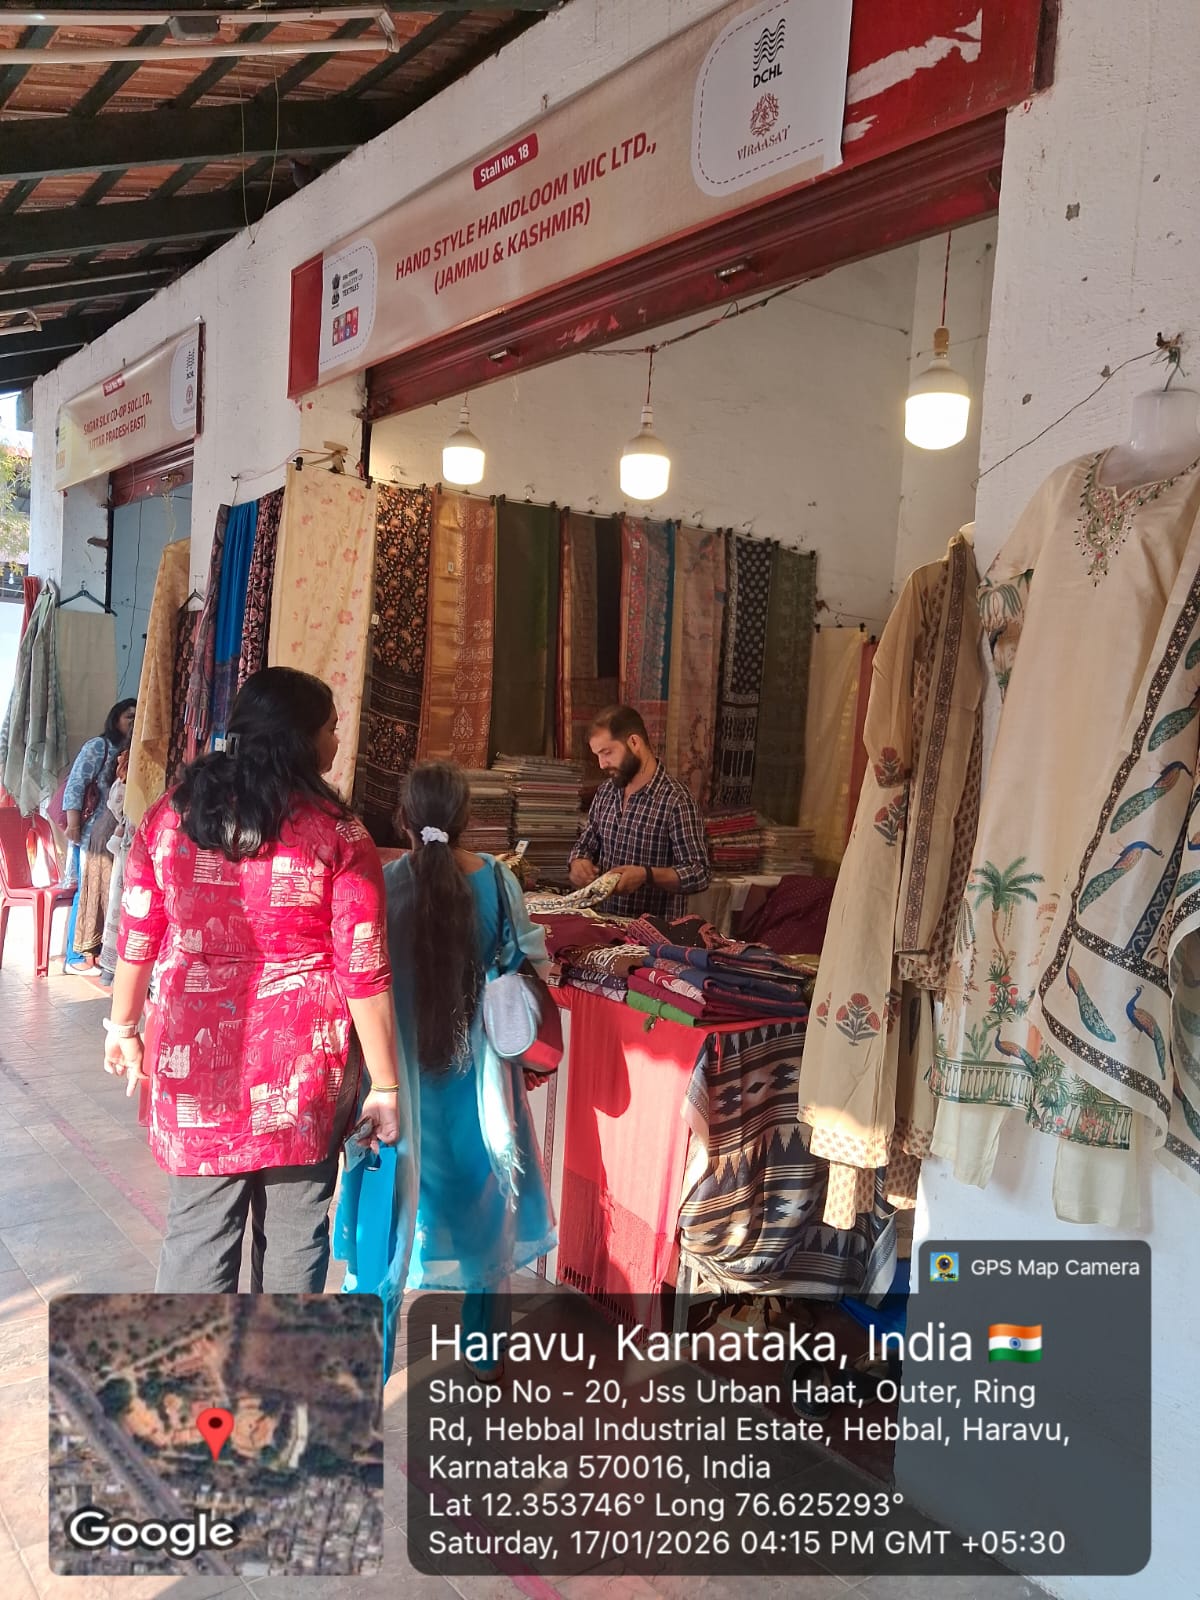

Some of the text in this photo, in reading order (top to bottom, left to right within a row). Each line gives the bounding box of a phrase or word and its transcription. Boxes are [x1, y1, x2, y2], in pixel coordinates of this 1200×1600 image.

[753, 63, 783, 88] DCHL
[480, 143, 529, 183] Stall No. 18
[736, 128, 790, 161] VIRAASAT
[396, 131, 657, 281] HAND STYLE HANDLOOM WIC LTD.,
[434, 197, 591, 295] (JAMMU & KASHMIR)
